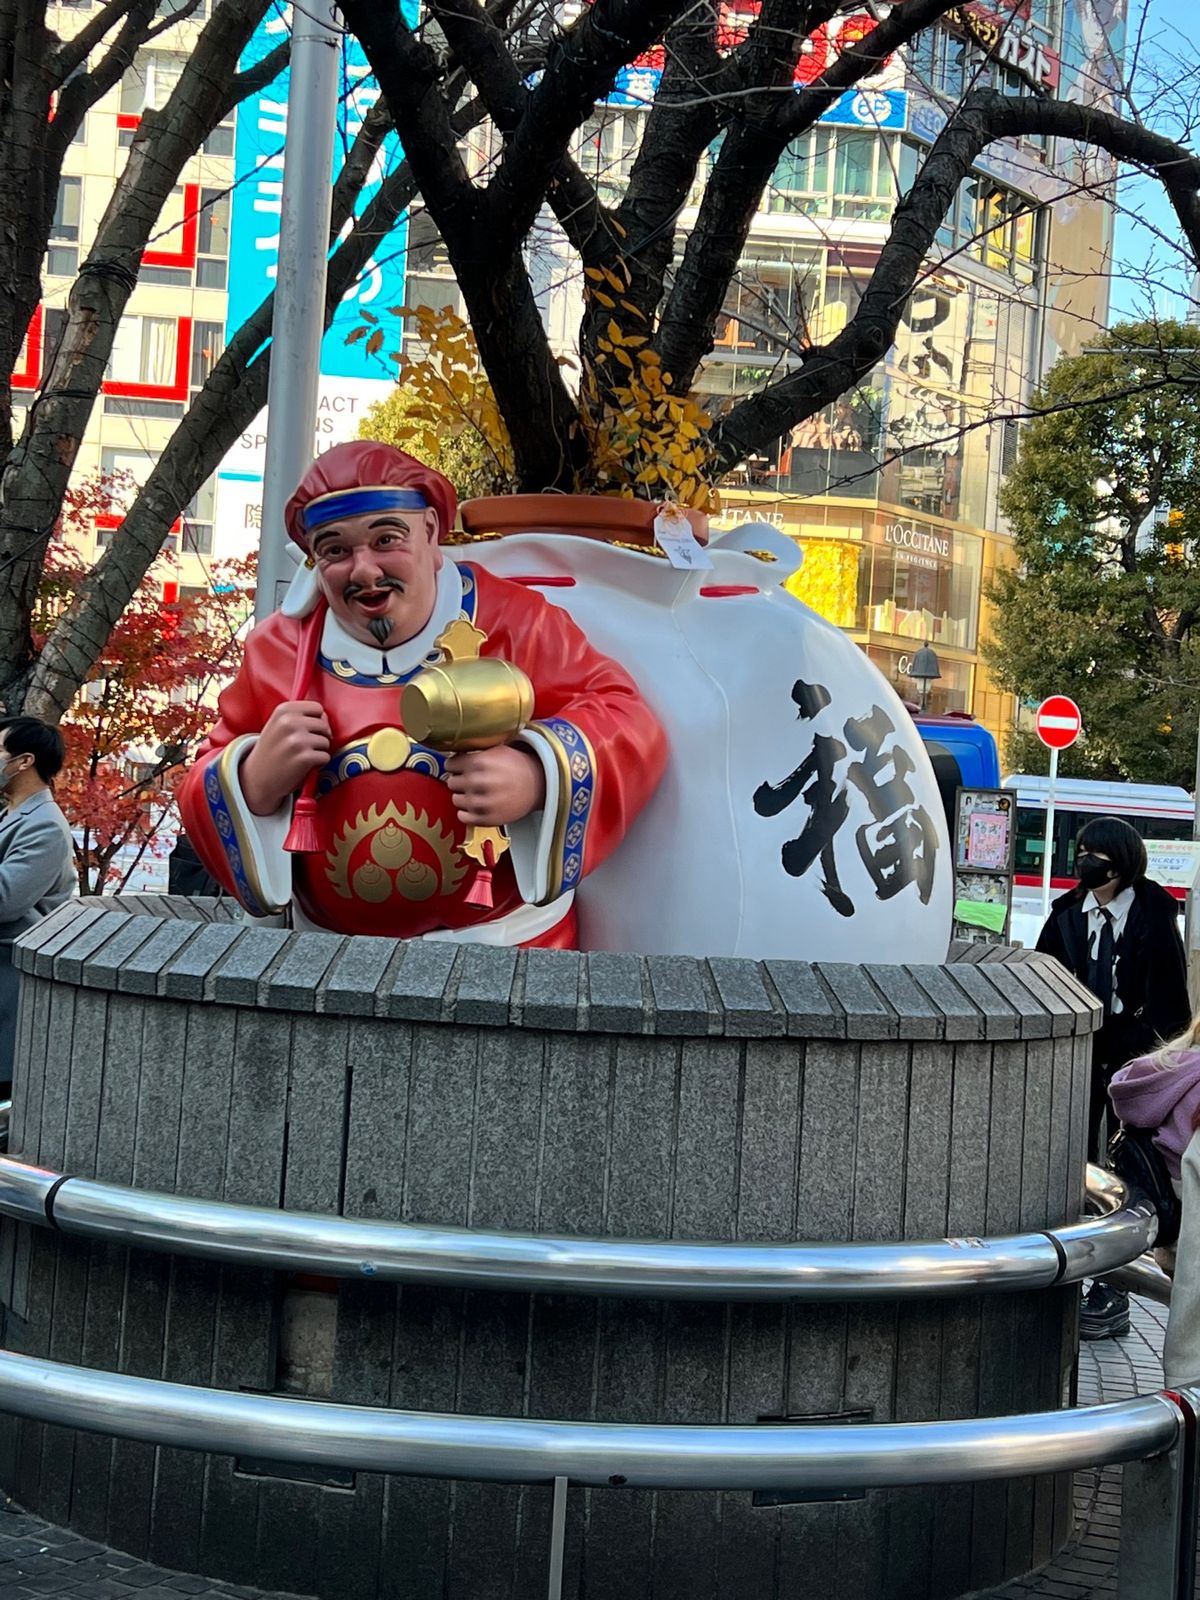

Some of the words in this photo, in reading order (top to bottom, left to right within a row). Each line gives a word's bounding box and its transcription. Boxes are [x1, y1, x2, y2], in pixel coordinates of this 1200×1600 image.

[1000, 24, 1051, 85] ガスト
[319, 396, 359, 413] ACT
[885, 524, 949, 557] L'OCCITANE
[752, 679, 940, 917] 福
